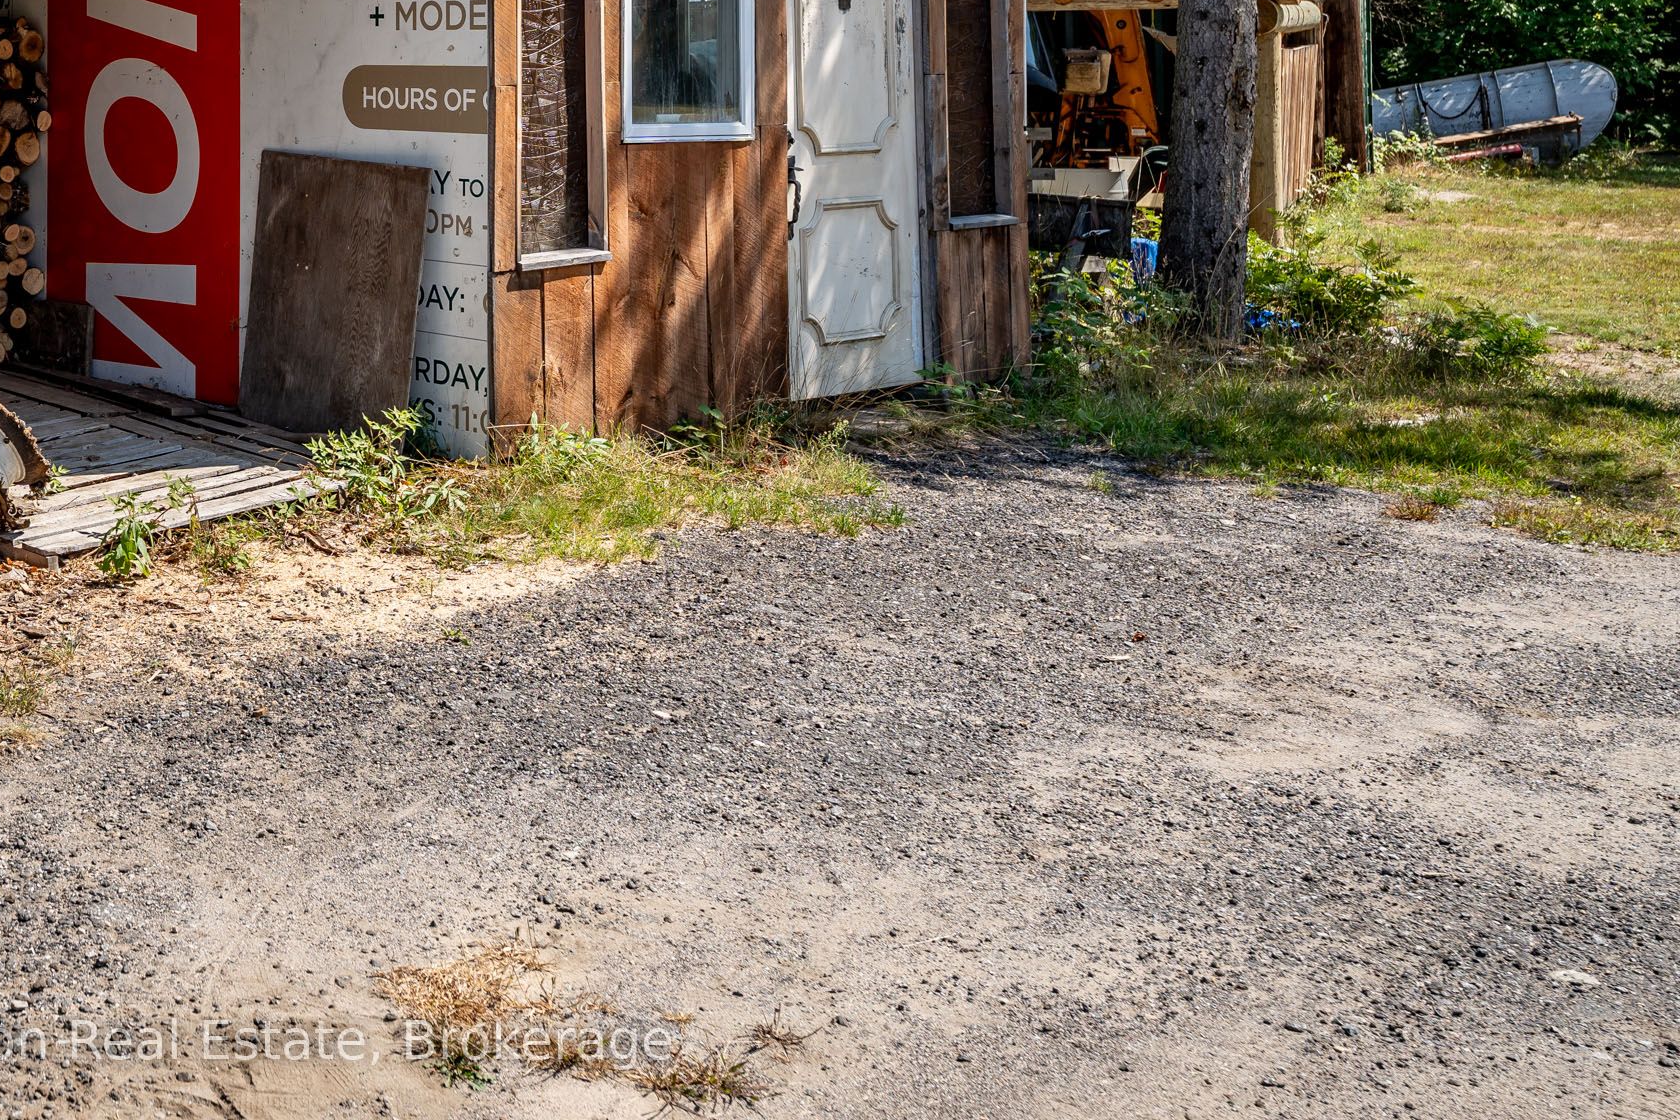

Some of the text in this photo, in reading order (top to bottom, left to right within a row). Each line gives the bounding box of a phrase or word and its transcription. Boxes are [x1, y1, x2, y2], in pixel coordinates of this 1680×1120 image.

[395, 0, 488, 31] MODE
[361, 86, 439, 111] HOURS
[443, 88, 477, 112] OF
[458, 178, 484, 198] TO
